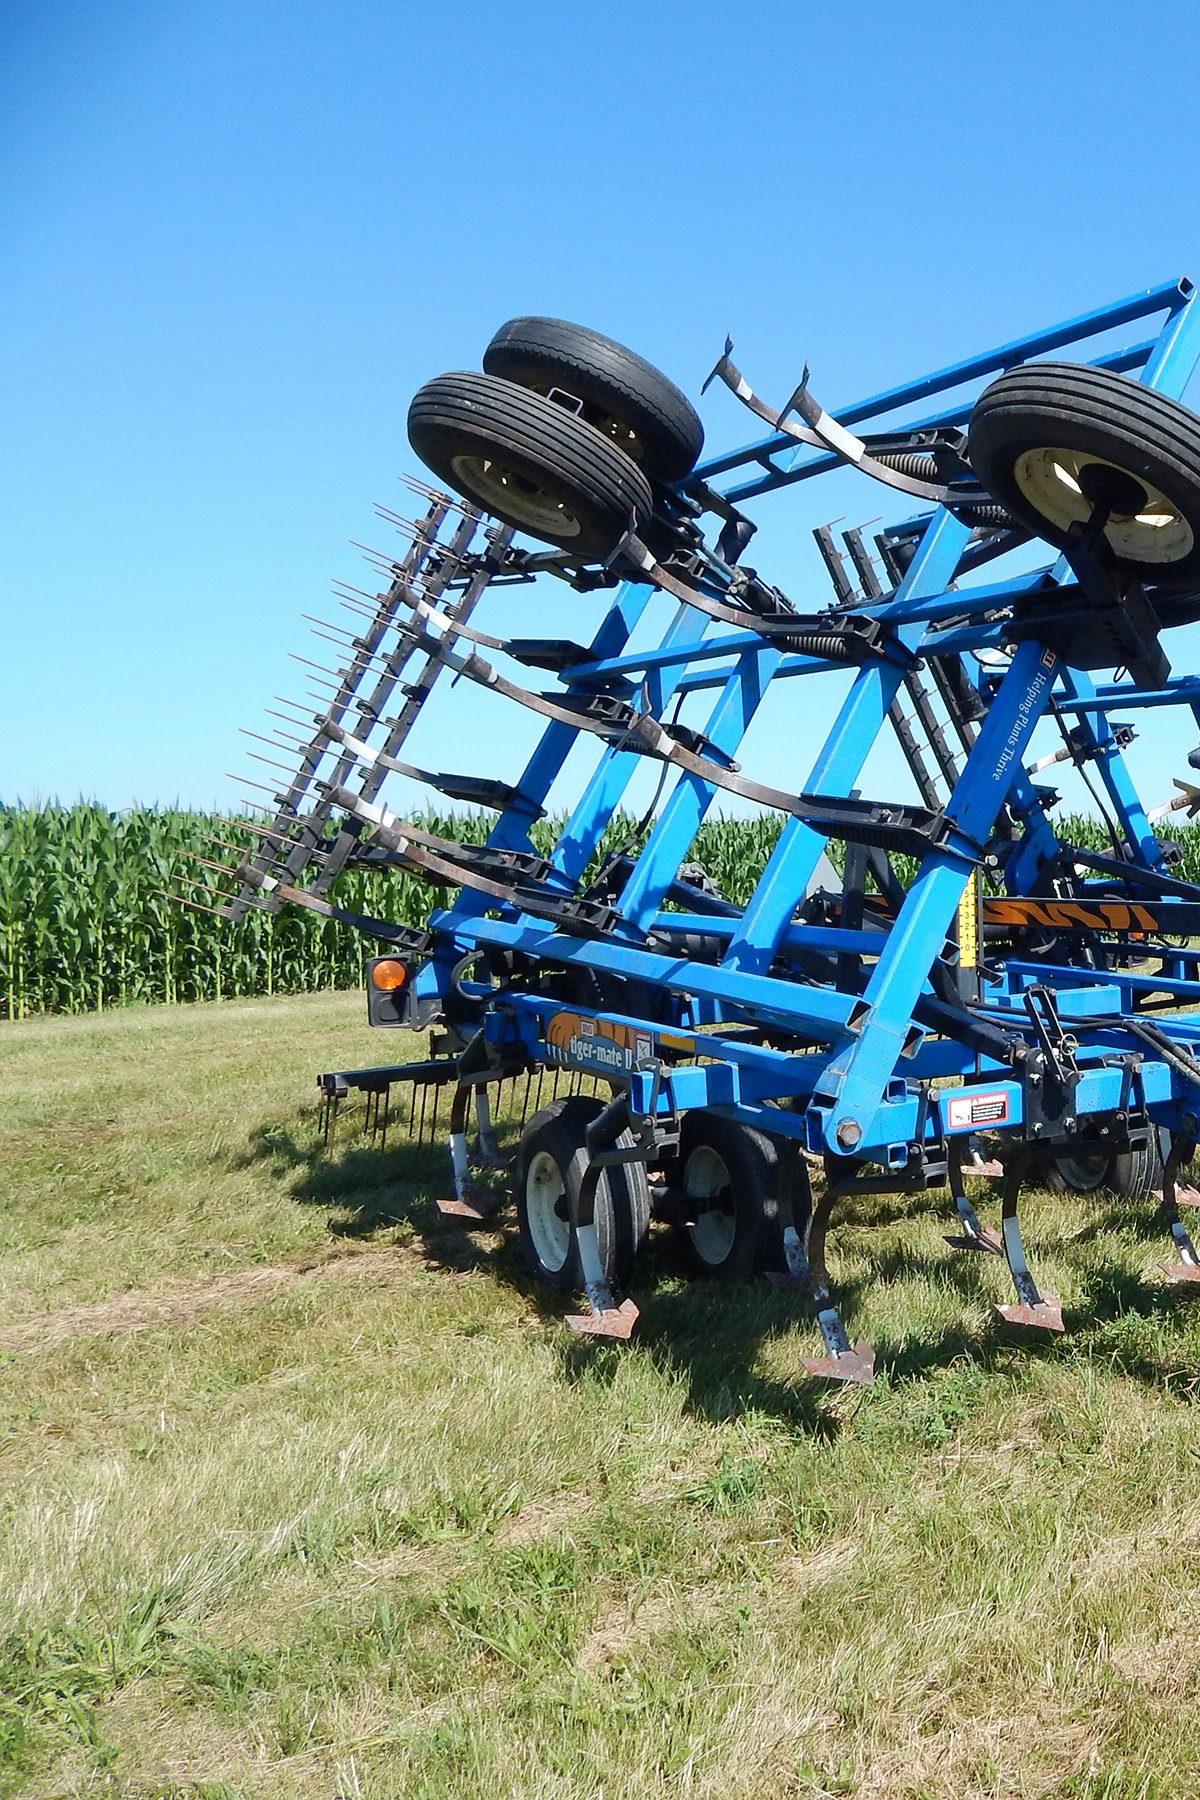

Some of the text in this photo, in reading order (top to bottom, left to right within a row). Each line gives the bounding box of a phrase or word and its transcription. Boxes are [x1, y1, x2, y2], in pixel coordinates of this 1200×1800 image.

[992, 672, 1047, 781] Helping Plants Thrive
[570, 1034, 623, 1068] tiger-mate
